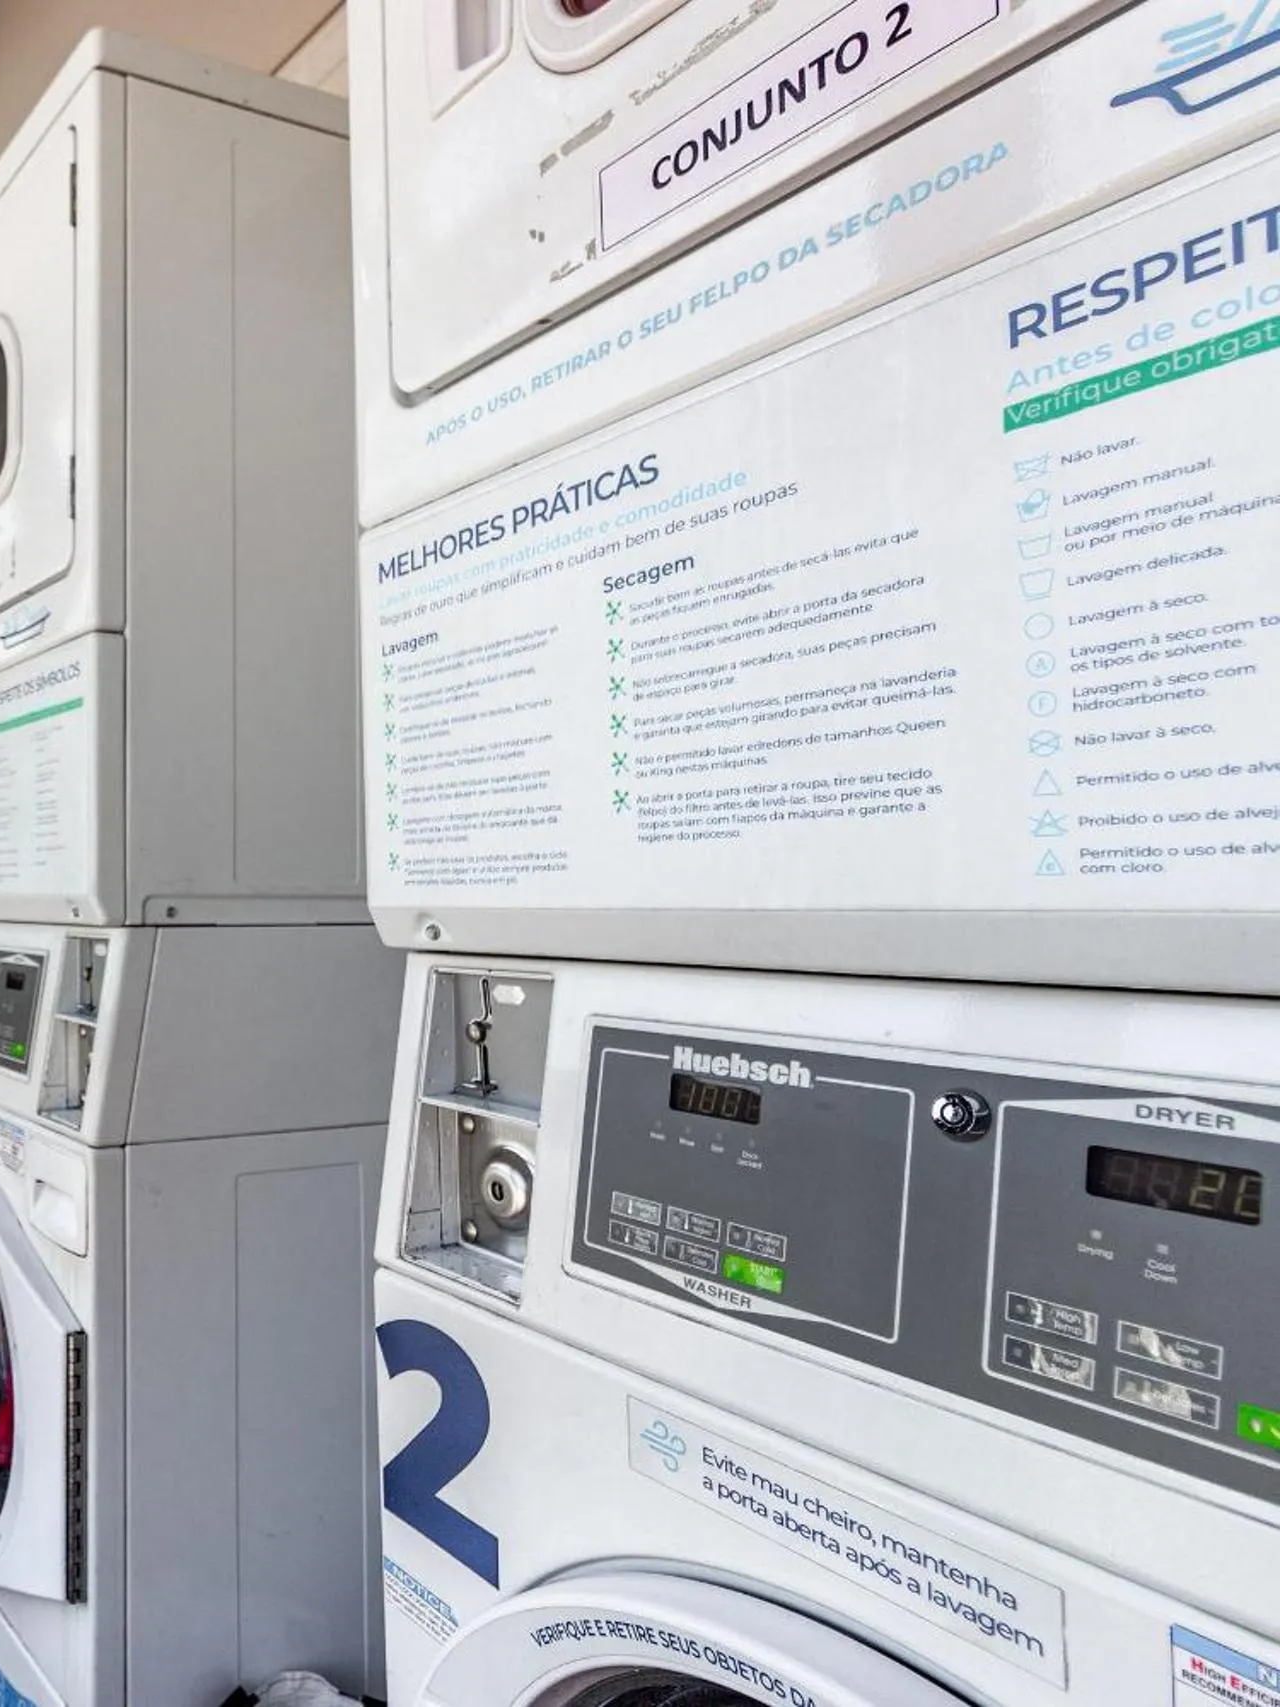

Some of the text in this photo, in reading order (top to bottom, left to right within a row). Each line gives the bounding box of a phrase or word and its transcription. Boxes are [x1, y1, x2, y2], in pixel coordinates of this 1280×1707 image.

[651, 2, 913, 190] CONJUNTO 2
[470, 405, 483, 421] O
[487, 386, 526, 412] USO,
[531, 341, 611, 393] RETIRAR
[618, 329, 633, 350] O
[639, 303, 683, 340] SEU
[689, 261, 771, 315] FELPO
[778, 236, 819, 272] DA
[825, 142, 1010, 248] SECADORA
[1008, 206, 1280, 349] RESPEIT
[1006, 342, 1115, 394] Antes
[1125, 322, 1176, 351] de
[1007, 369, 1142, 424] Verifique
[1060, 449, 1093, 465] Não
[614, 471, 746, 527] comodidade
[1061, 457, 1215, 506] Lavagem manual.
[377, 453, 658, 583] MELHORES PRÁTICAS
[567, 540, 621, 567] cuidam
[625, 527, 660, 549] bem
[663, 519, 686, 535] de
[689, 505, 728, 528] suas
[732, 482, 798, 512] roupas
[1063, 491, 1213, 537] Lavagem manual
[1063, 539, 1085, 552] ou
[1089, 531, 1116, 548] por
[1121, 521, 1167, 539] meio
[1170, 514, 1194, 528] de
[602, 555, 694, 593] Secagem
[1065, 546, 1224, 586] Lavagem delicada.
[860, 575, 925, 598] secadora
[1067, 604, 1144, 626] Lavagem
[381, 631, 438, 657] Lavagem
[1069, 637, 1146, 658] Lavagem
[1164, 626, 1207, 642] seco
[1211, 620, 1254, 635] com
[1069, 660, 1089, 673] os
[1091, 654, 1134, 670] tipos
[1137, 649, 1160, 662] de
[1071, 679, 1148, 697] Lavagem
[1166, 671, 1209, 685] seco
[1213, 664, 1256, 679] com
[1073, 733, 1107, 745] Não
[1110, 729, 1150, 742] lavar
[1075, 770, 1160, 786] Permitido
[1162, 769, 1176, 780] o
[1179, 766, 1213, 779] uso
[1217, 763, 1243, 776] de
[1077, 813, 1148, 827] Proibido
[1151, 812, 1164, 824] o
[1167, 810, 1201, 823] uso
[1204, 808, 1230, 821] de
[1078, 845, 1163, 859] Permitido
[1166, 846, 1180, 857] o
[1182, 845, 1217, 856] uso
[1220, 843, 1246, 855] de
[1079, 863, 1116, 874] com
[672, 1045, 812, 1088] Huebsch
[1135, 1103, 1236, 1131] DRYER
[1077, 1242, 1115, 1261] Drying
[682, 1275, 752, 1310] WASHER
[1144, 1268, 1178, 1285] Down
[376, 1318, 500, 1591] 2
[702, 1446, 1019, 1612] Evite mau cheiro, mantenha
[702, 1476, 1045, 1658] a porta aberta após a lavagem
[530, 1618, 596, 1648] VERIFIQUE
[596, 1619, 606, 1637] E
[605, 1619, 659, 1646] RETIRE
[658, 1629, 702, 1659] SEUS
[703, 1645, 787, 1699] OBJETOS
